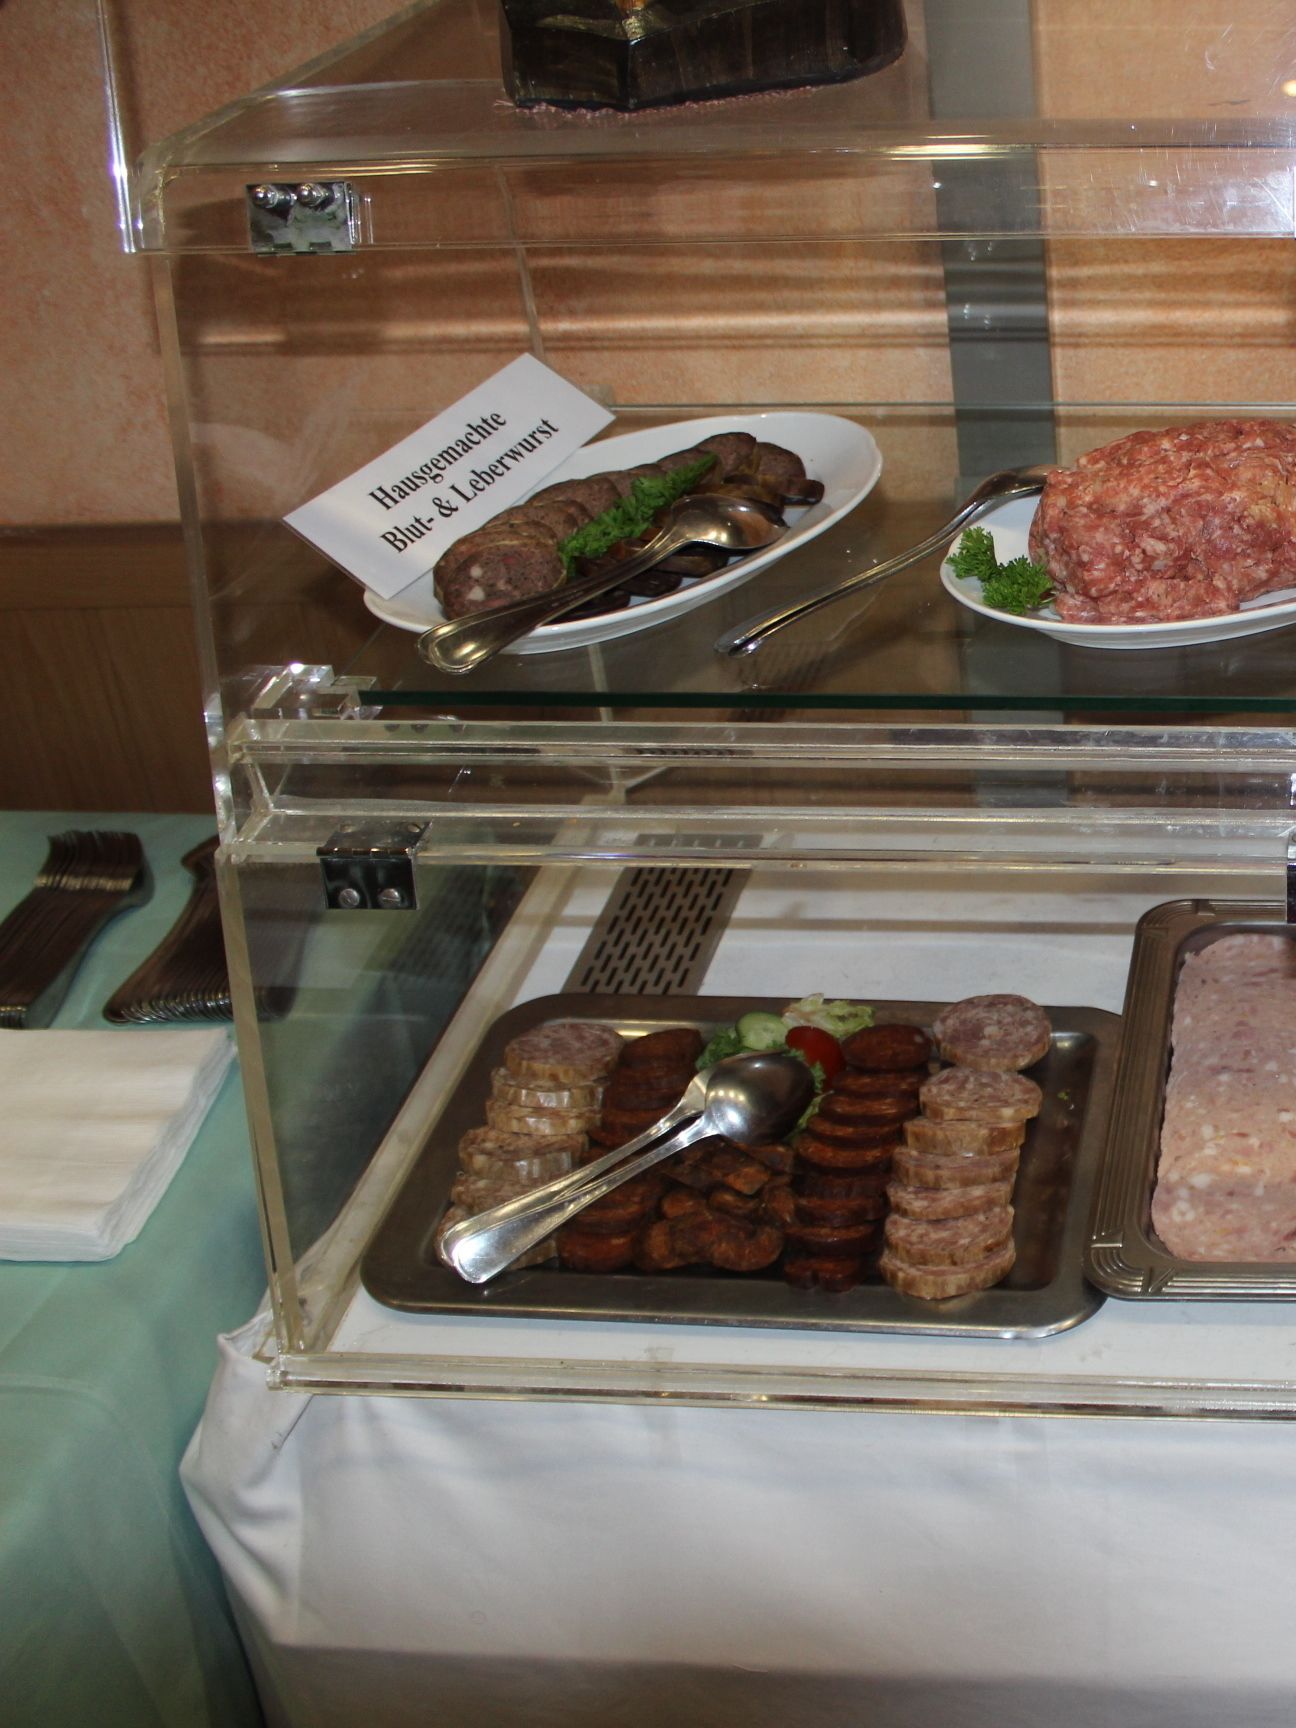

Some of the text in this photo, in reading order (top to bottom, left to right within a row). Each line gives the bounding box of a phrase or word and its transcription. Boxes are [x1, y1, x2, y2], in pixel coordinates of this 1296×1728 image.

[367, 412, 507, 512] Hausgemachte
[380, 418, 560, 554] Blut- & Leberwurst
